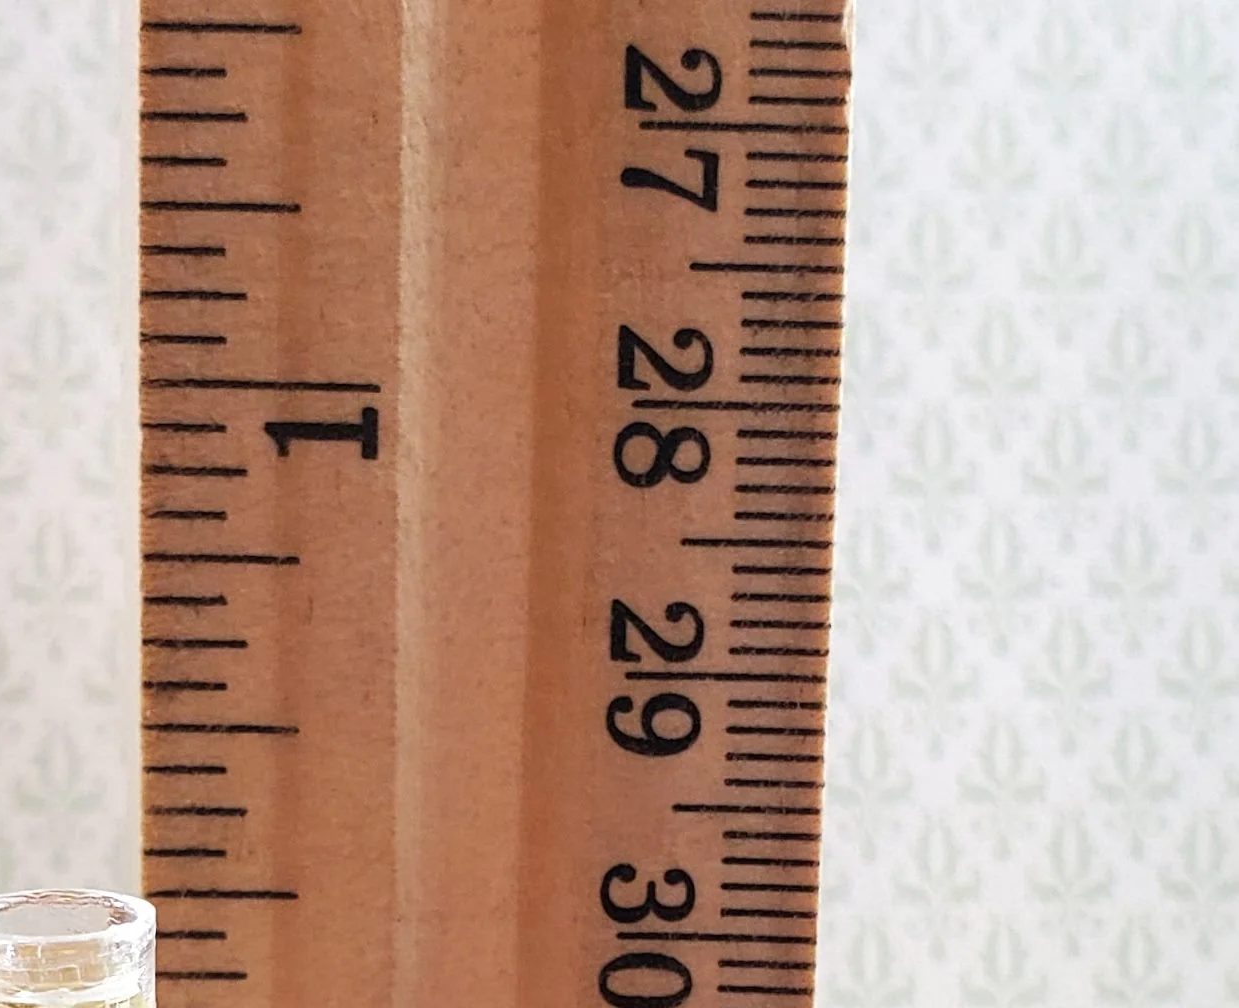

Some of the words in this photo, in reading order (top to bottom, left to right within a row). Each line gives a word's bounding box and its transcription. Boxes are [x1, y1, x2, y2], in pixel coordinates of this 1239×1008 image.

[620, 44, 722, 213] 27
[265, 406, 378, 460] 1
[613, 324, 714, 488] 28
[605, 597, 705, 758] 29
